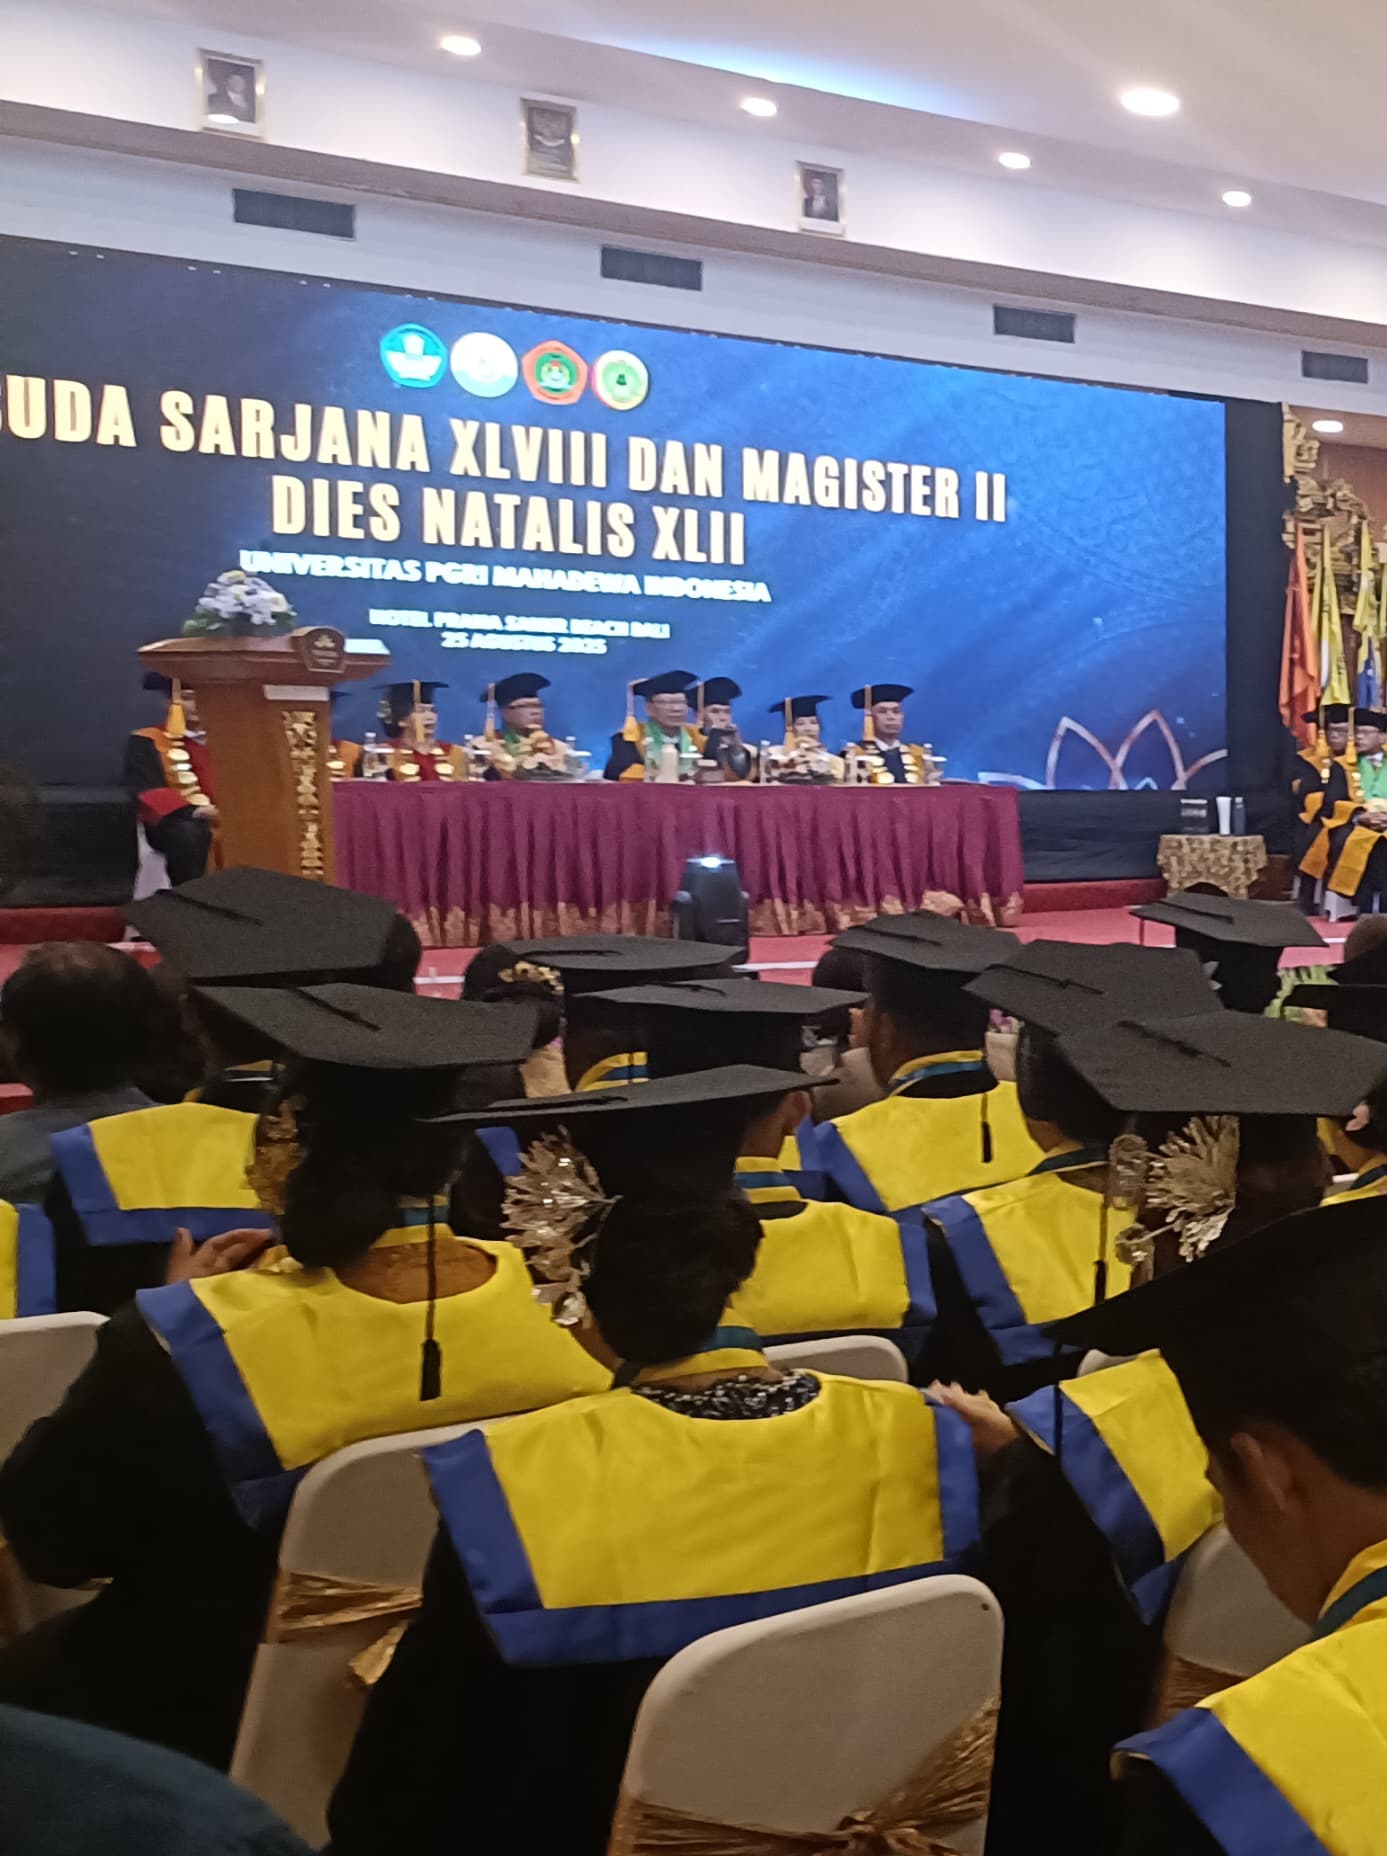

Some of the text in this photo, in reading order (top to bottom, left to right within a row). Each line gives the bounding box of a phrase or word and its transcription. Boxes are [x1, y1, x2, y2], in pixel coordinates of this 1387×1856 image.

[0, 374, 1007, 522] UDA SARJANA XLVIII DAN MAGISTER II
[271, 474, 745, 565] DIES NATALIS XLII
[239, 550, 422, 582] UNIVERSITAS
[425, 561, 489, 586] PGRI
[643, 575, 772, 602] INDONESIA
